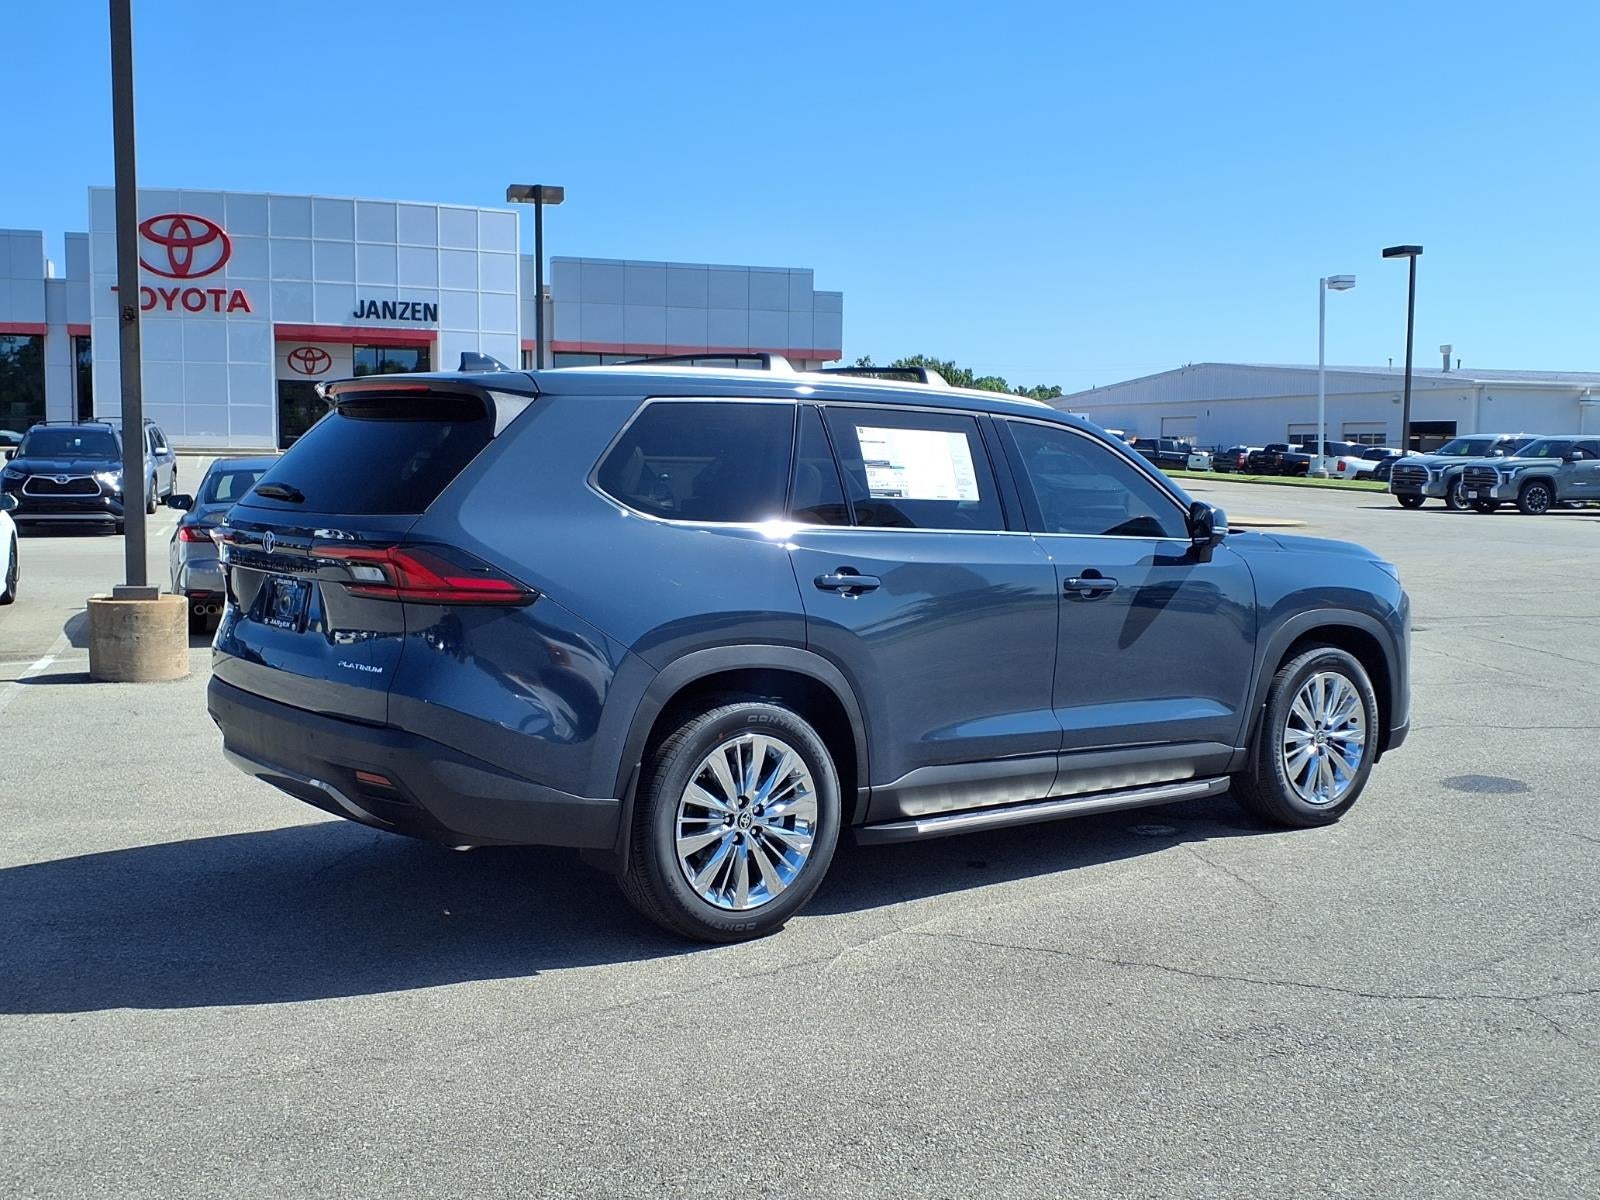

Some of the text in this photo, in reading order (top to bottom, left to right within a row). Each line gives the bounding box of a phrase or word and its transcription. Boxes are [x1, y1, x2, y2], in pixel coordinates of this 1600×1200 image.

[111, 286, 251, 312] OYOTA
[353, 300, 437, 321] JANZEN
[338, 660, 383, 673] PLATINUM
